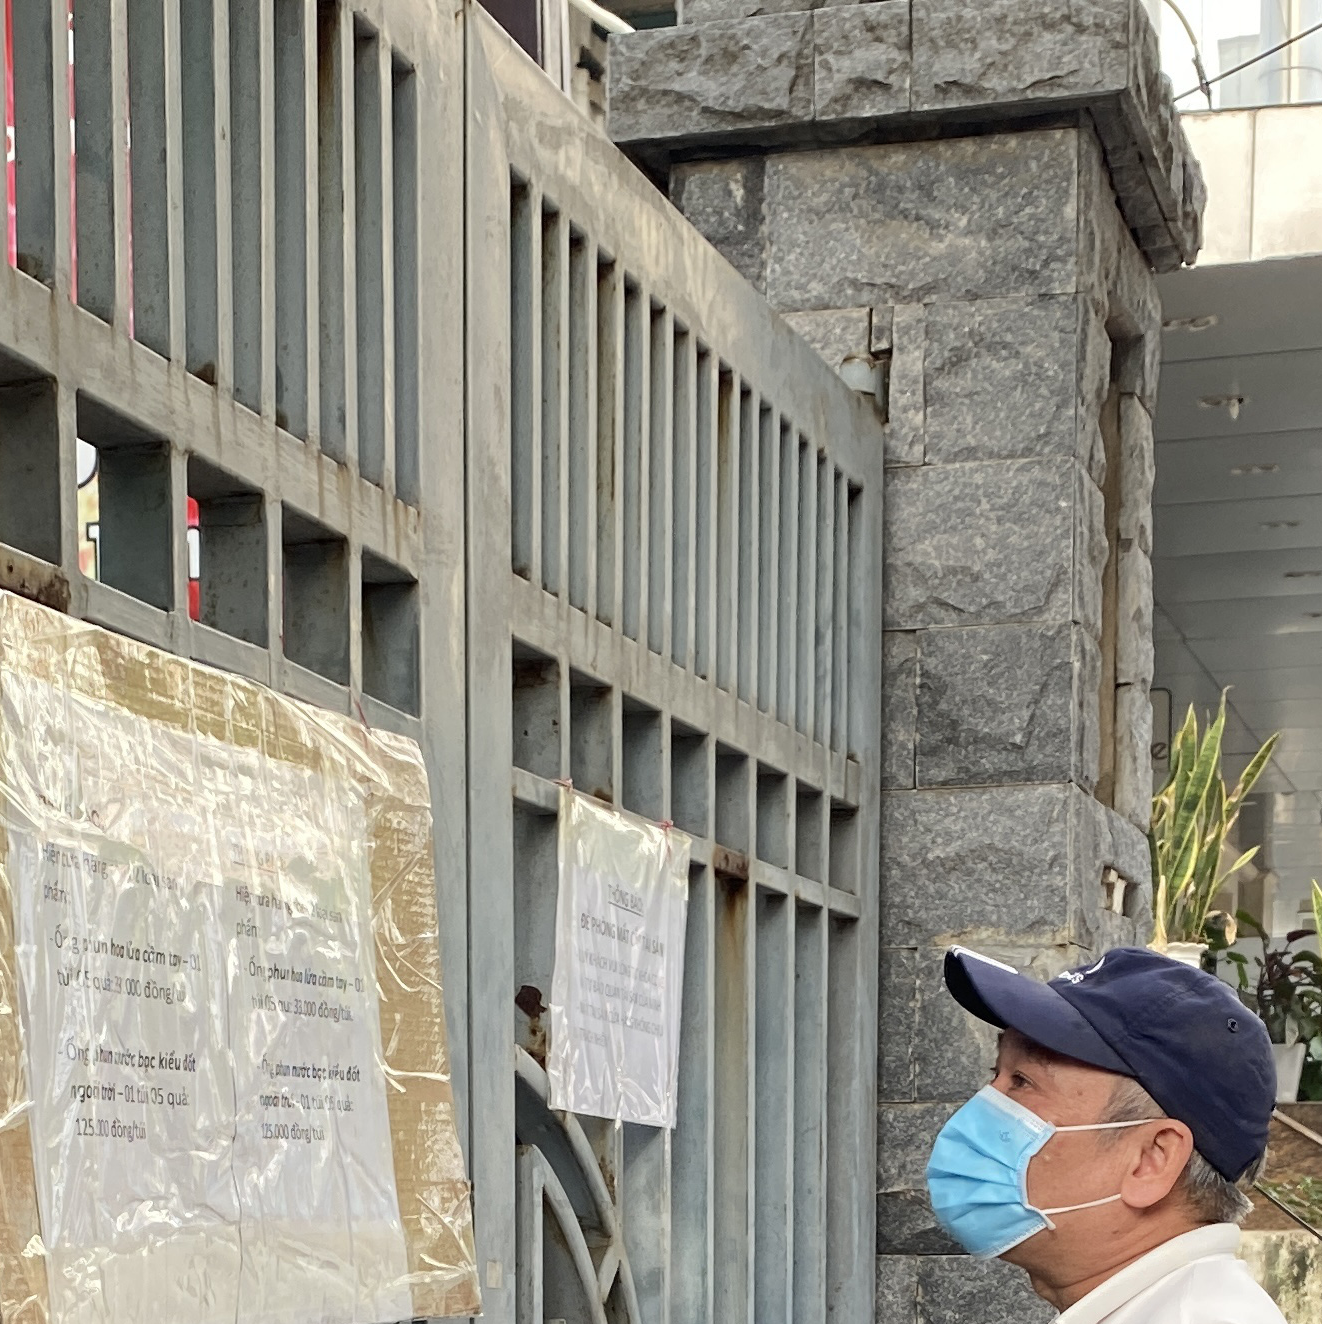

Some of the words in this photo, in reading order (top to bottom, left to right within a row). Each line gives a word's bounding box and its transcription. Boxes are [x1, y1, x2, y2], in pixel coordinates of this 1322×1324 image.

[137, 1050, 156, 1073] bạc
[158, 1050, 181, 1071] kiểu
[182, 1052, 196, 1073] đốt
[346, 1065, 361, 1082] đốt
[124, 1084, 136, 1103] 01
